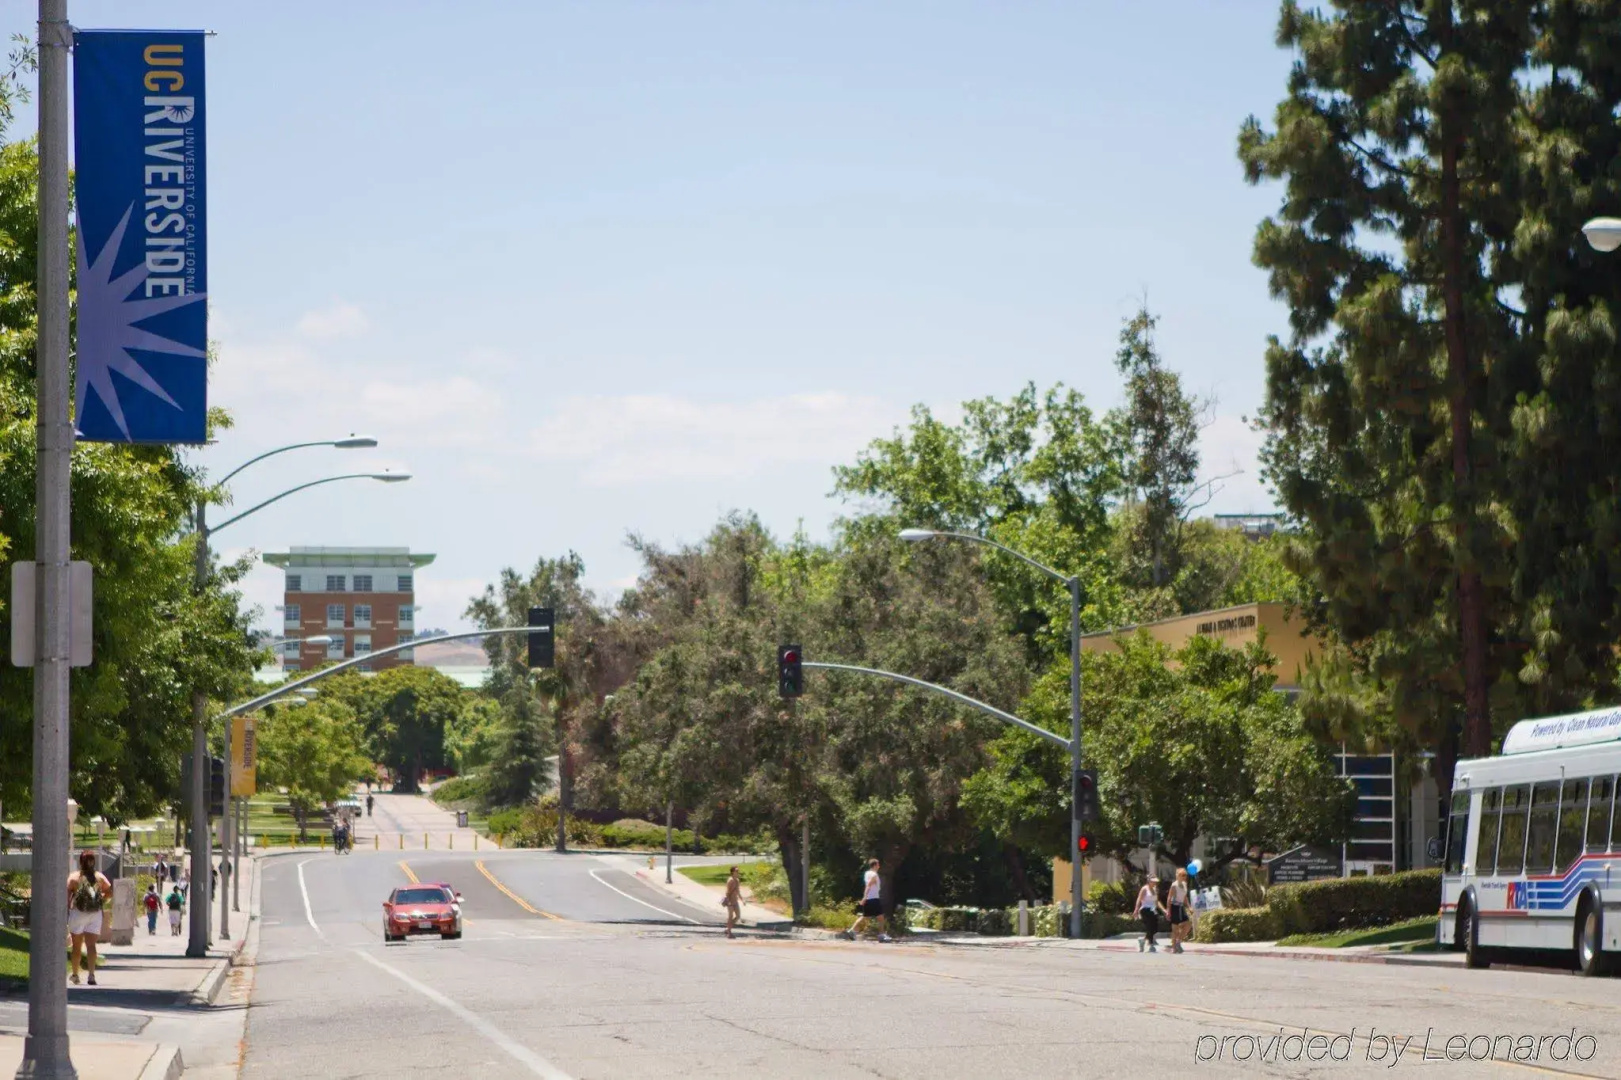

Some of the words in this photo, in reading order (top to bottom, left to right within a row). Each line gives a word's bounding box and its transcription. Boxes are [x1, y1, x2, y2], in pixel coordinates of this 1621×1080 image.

[185, 127, 195, 200] UNIVERSITY
[186, 204, 195, 219] OF
[185, 223, 195, 297] CALIFORNIA
[1531, 722, 1558, 737] Powered
[1567, 718, 1585, 732] Clean
[1585, 713, 1611, 730] Natural
[1507, 882, 1528, 909] RTA
